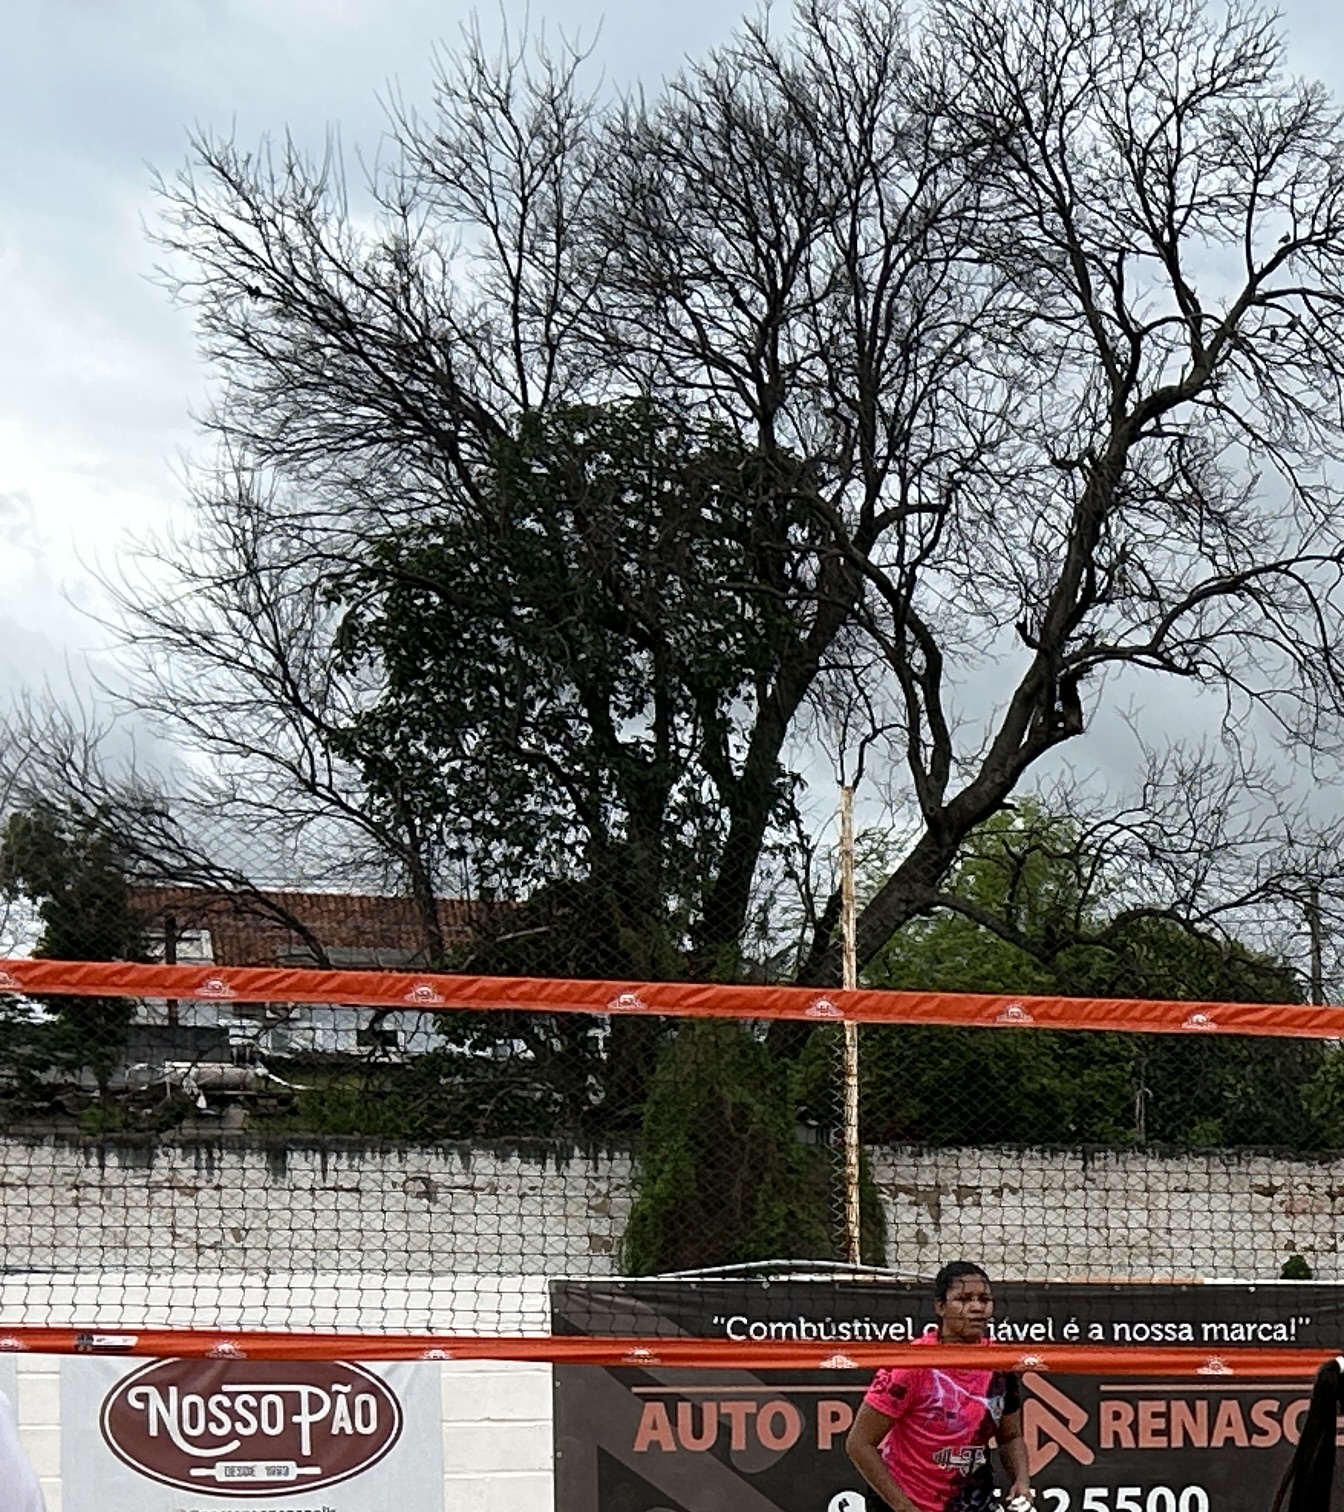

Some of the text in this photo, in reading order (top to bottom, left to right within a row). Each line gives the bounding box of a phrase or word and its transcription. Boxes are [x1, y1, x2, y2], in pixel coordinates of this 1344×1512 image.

[1063, 1317, 1081, 1341] é
[1088, 1323, 1105, 1341] a
[1113, 1322, 1195, 1342] nossa
[127, 1385, 286, 1457] NOSSO
[632, 1399, 802, 1453] AUTO
